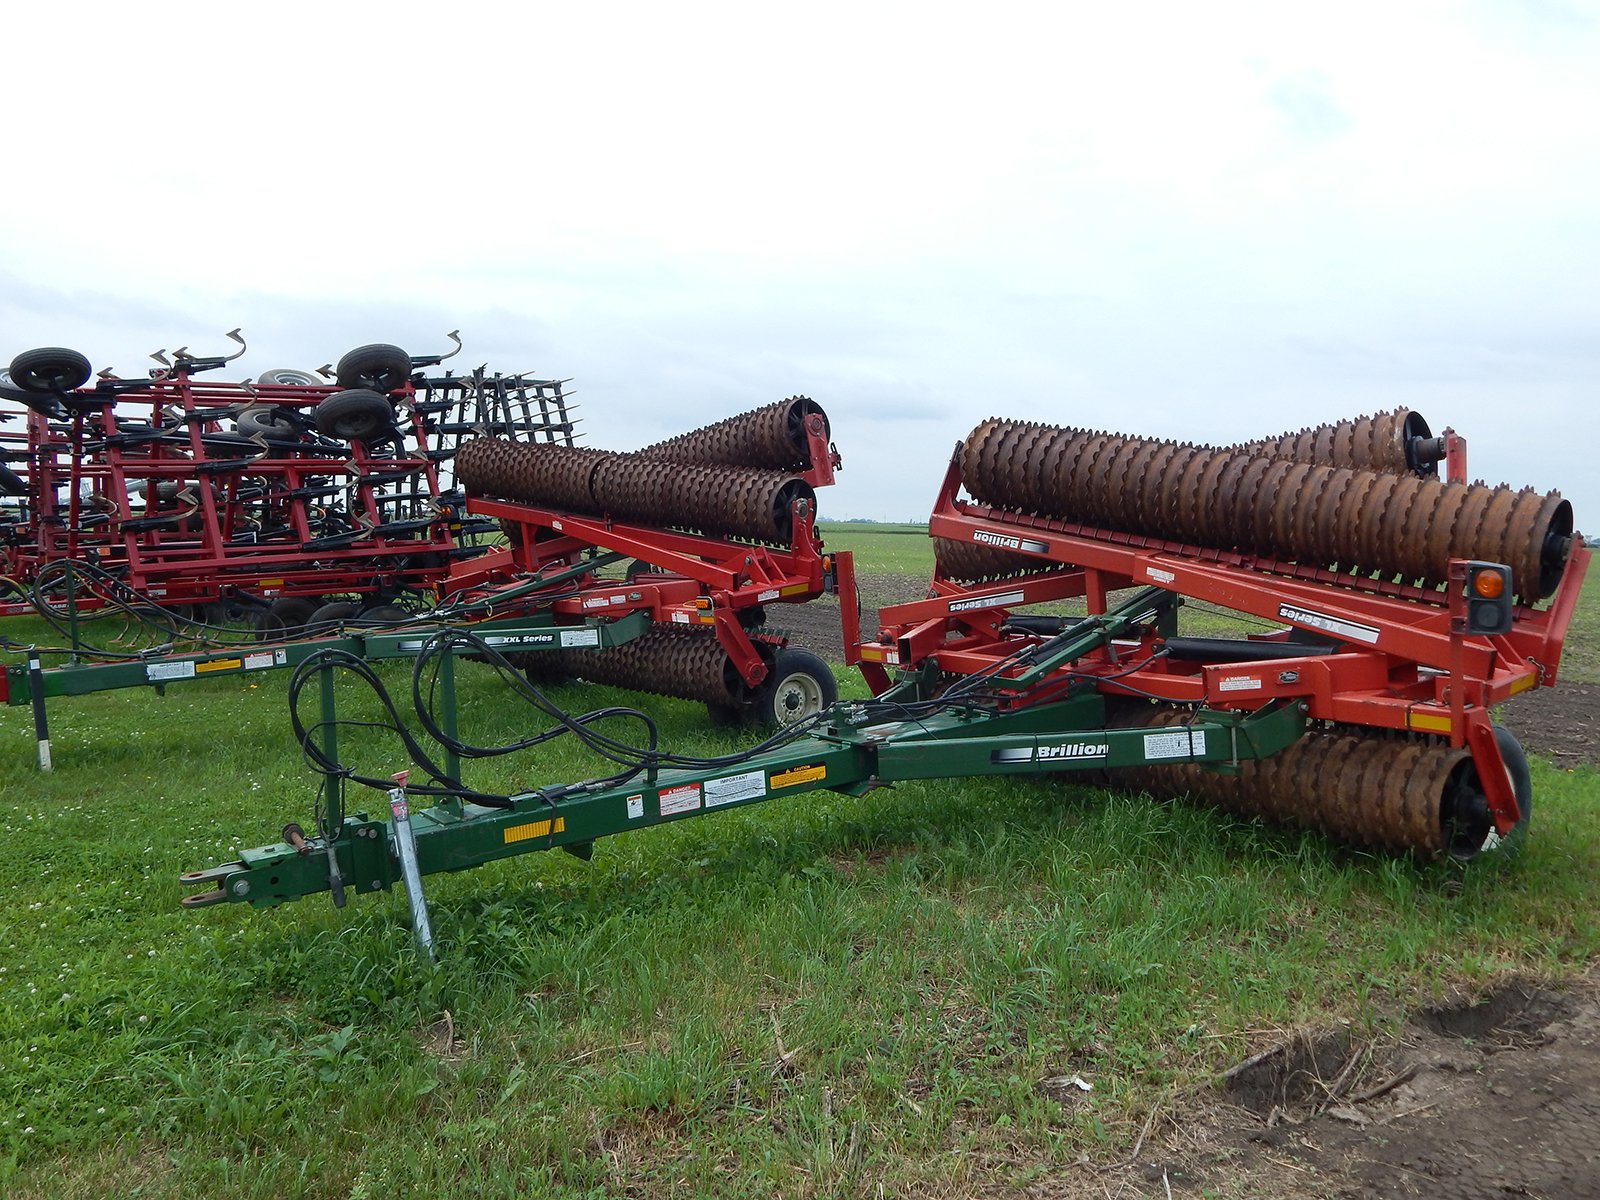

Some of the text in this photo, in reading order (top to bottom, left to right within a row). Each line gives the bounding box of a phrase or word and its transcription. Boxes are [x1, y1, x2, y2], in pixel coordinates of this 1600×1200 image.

[973, 532, 1020, 548] Brillion
[950, 601, 981, 611] Series
[1280, 608, 1321, 626] Series
[522, 634, 553, 643] Series
[1036, 742, 1109, 758] Brillion
[720, 775, 748, 783] IMPORTANT
